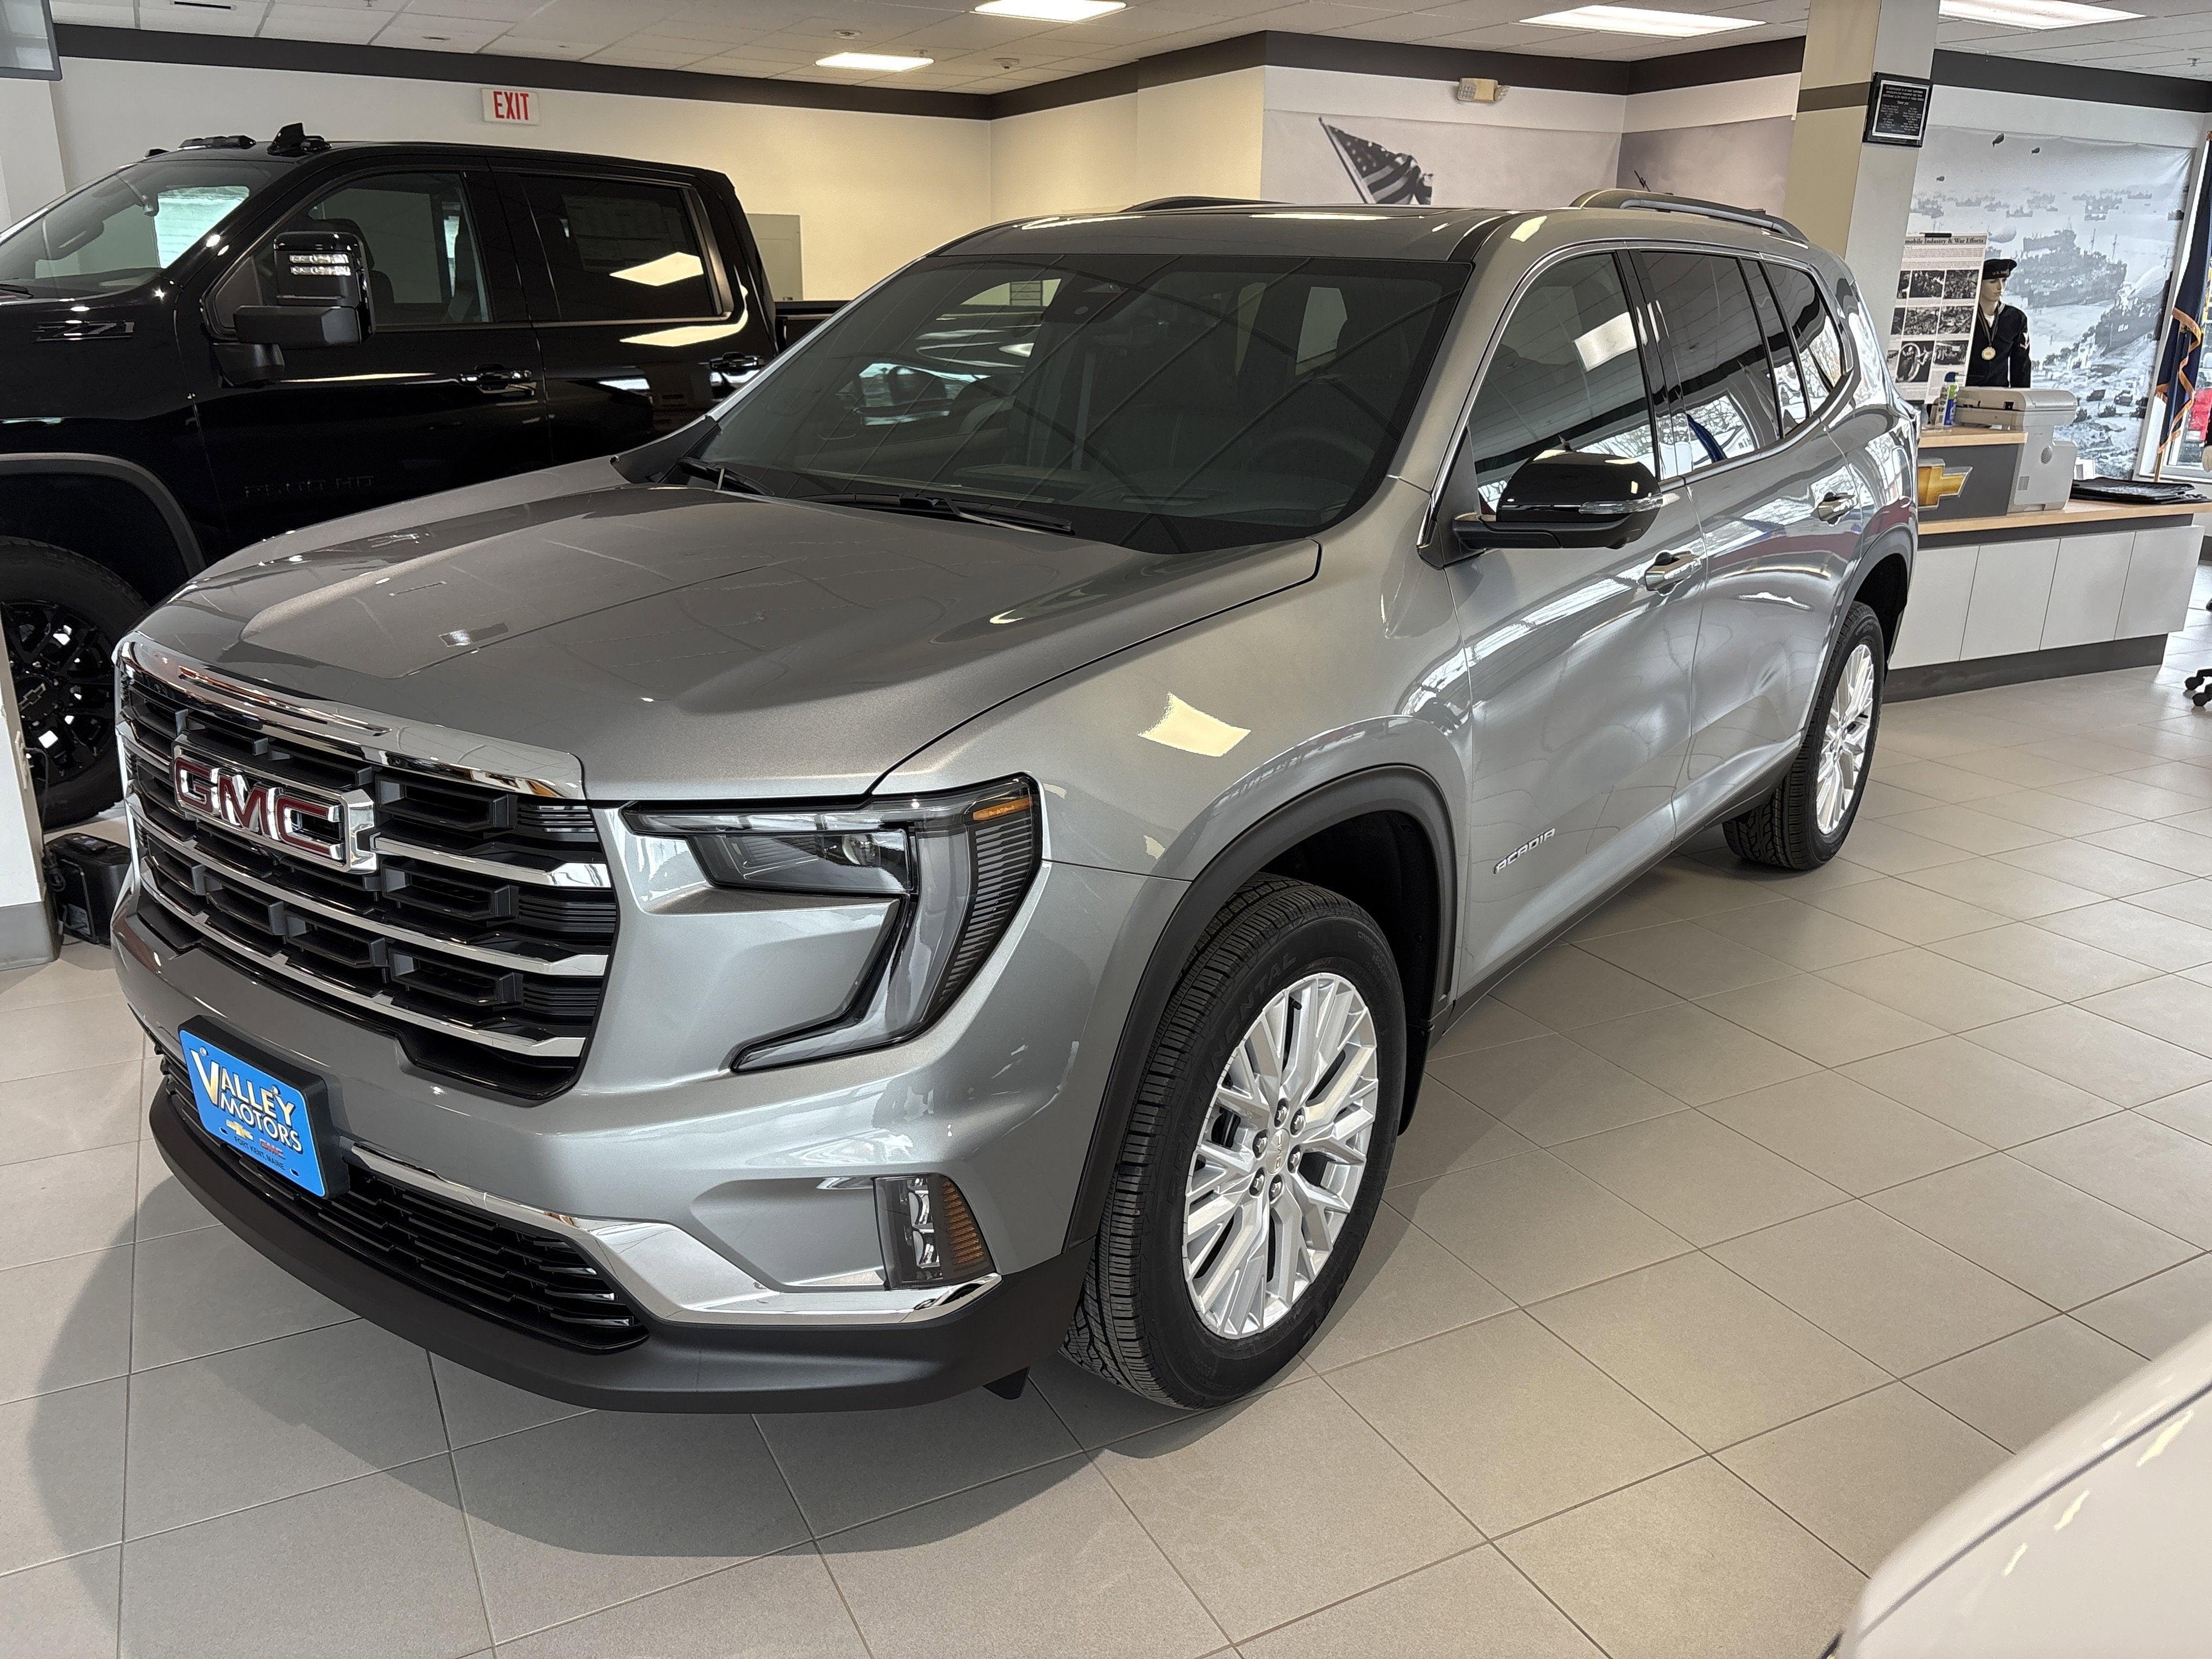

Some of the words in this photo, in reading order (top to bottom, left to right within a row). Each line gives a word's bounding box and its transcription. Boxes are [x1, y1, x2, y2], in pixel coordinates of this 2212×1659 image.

[493, 91, 529, 120] EXIT
[174, 755, 343, 861] GMC
[1494, 828, 1555, 873] ACADIA
[190, 1048, 297, 1128] VALLEY
[221, 1091, 303, 1154] MOTORS
